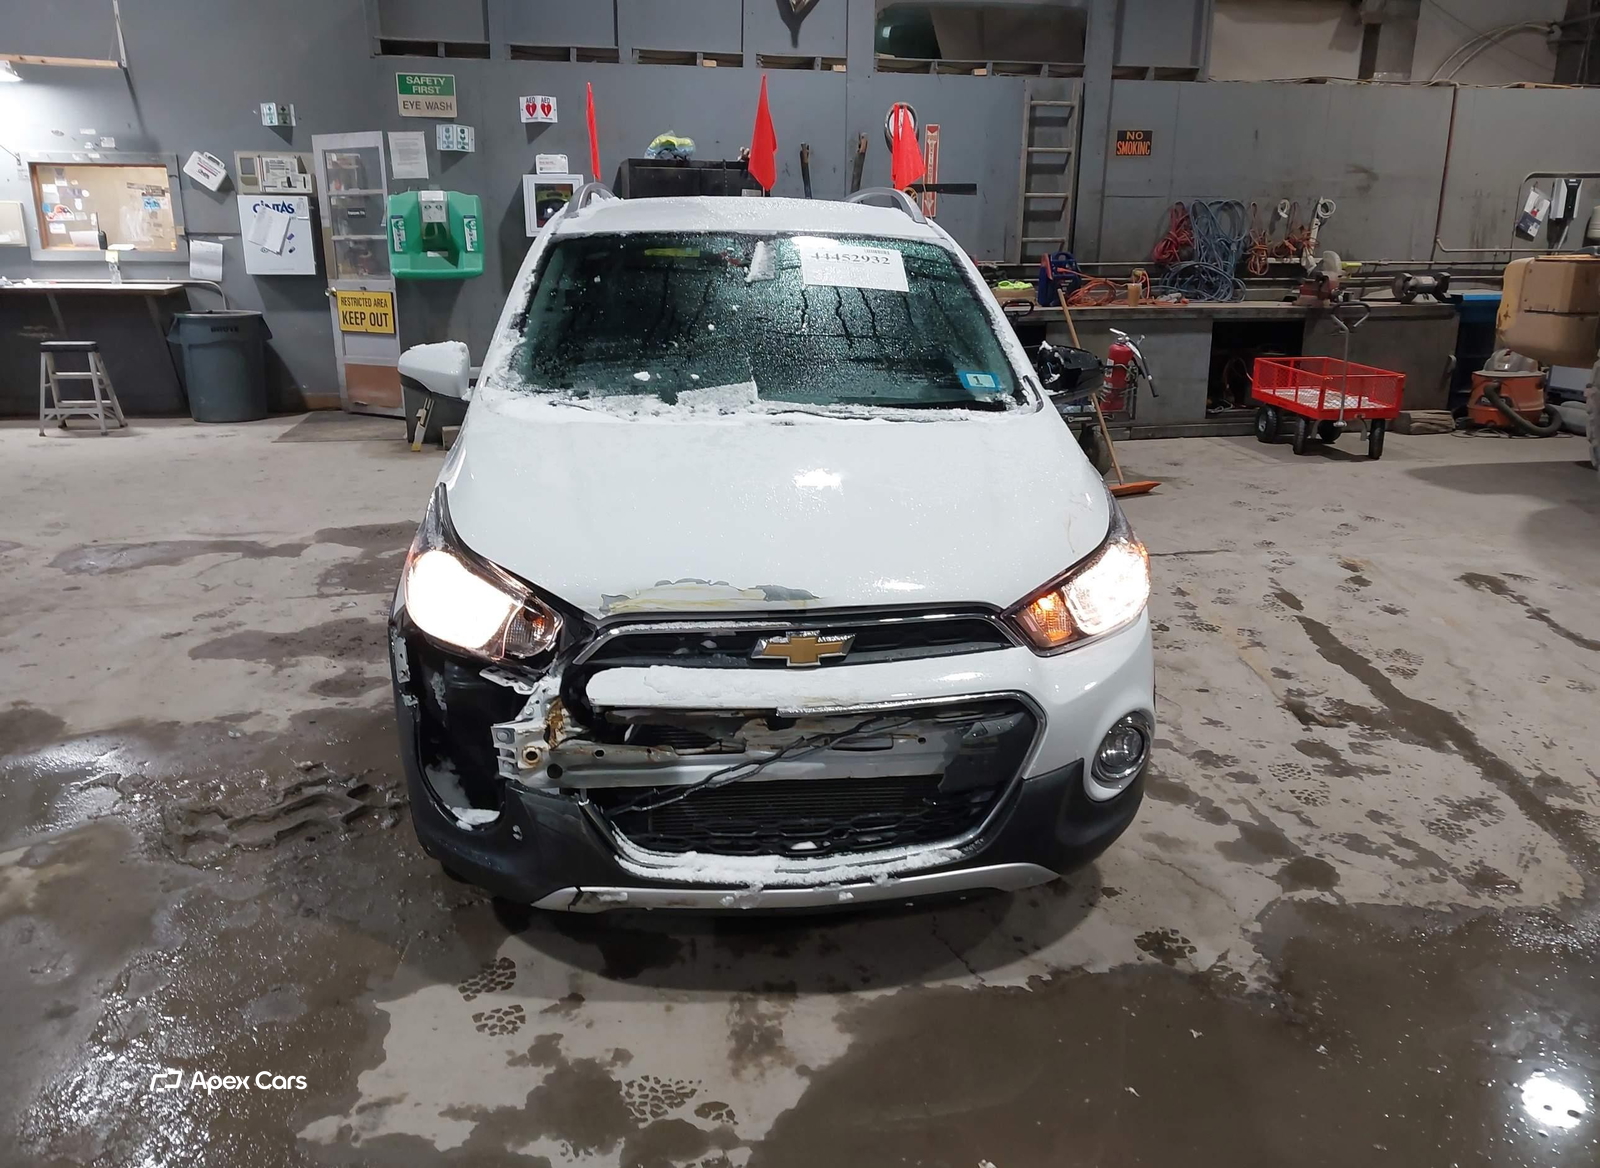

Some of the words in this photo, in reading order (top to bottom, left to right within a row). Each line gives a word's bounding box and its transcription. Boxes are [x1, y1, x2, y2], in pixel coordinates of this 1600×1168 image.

[406, 76, 446, 86] SAFETY
[412, 85, 441, 94] FIRST
[402, 100, 422, 110] EYE
[425, 101, 453, 111] WASH
[526, 96, 536, 104] AED
[541, 96, 551, 104] AED
[1126, 131, 1144, 140] NO
[1116, 140, 1151, 155] SMOKING
[811, 252, 891, 265] 44452932
[340, 296, 372, 308] RESTRICTED
[373, 298, 389, 309] AREA
[341, 310, 366, 326] KEEP
[369, 311, 389, 328] OUT
[973, 375, 983, 386] 1
